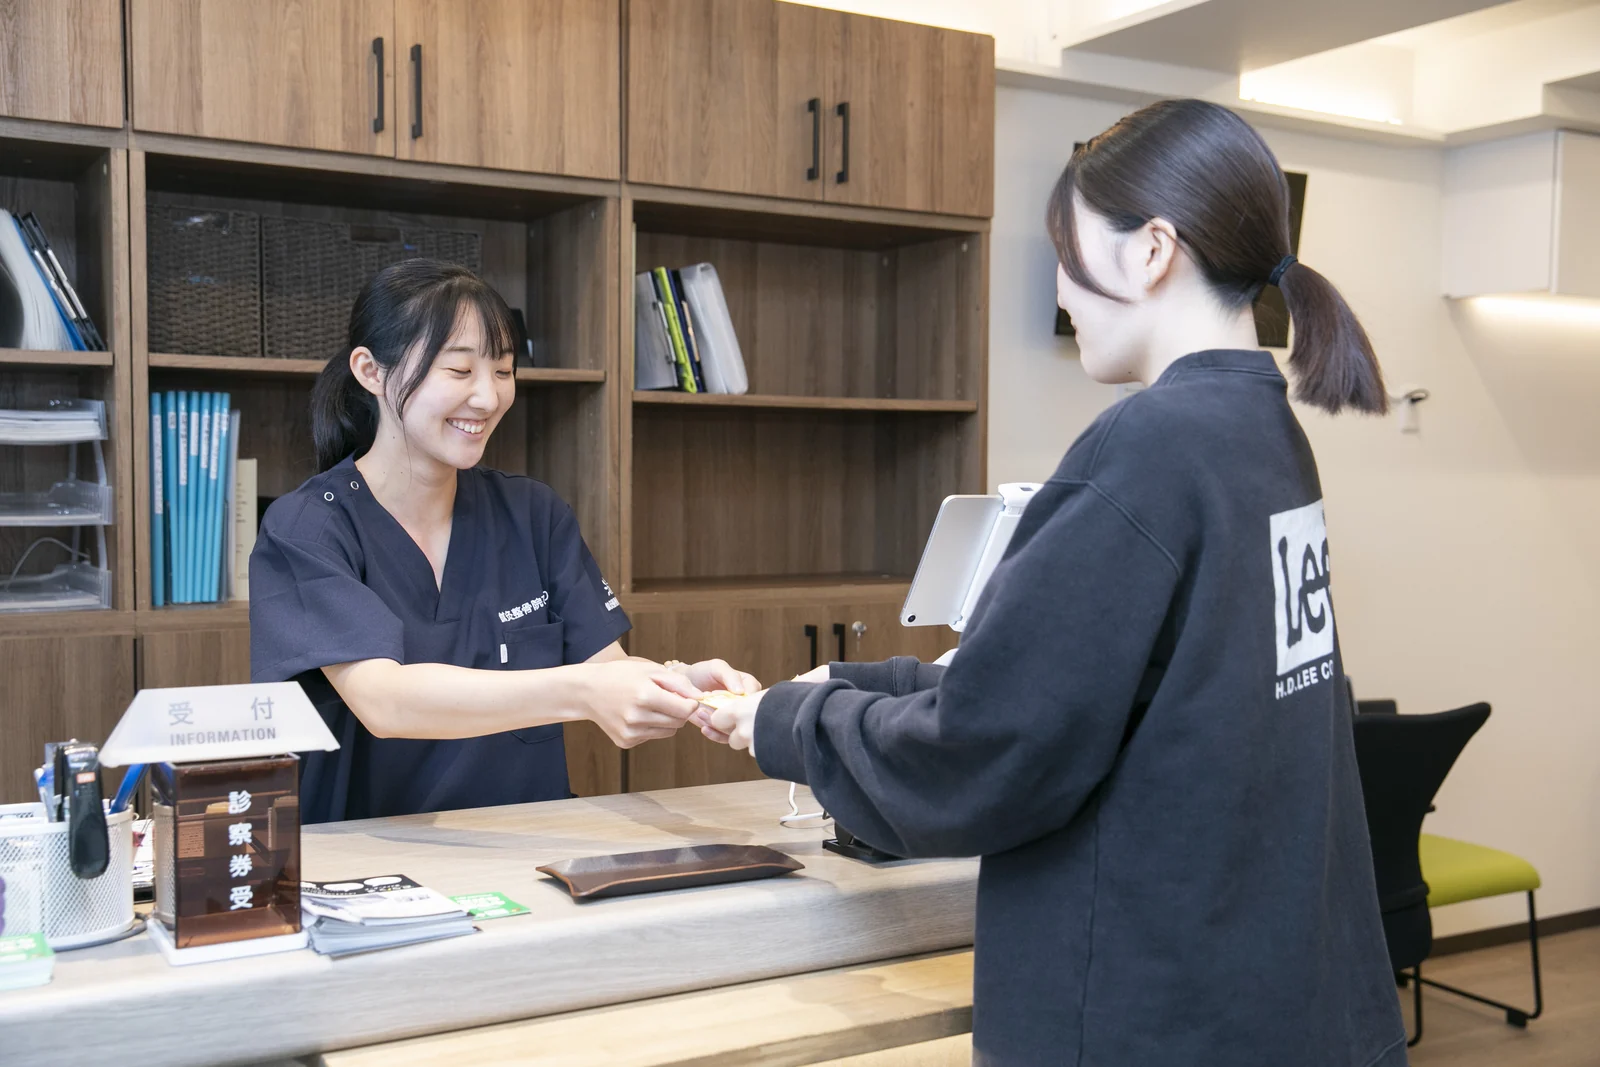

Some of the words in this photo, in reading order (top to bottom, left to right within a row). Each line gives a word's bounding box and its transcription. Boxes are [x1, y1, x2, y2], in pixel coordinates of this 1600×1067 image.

[1275, 666, 1319, 700] H.D.LEE
[170, 727, 277, 746] INFORMATION
[227, 790, 253, 911] 診察券受
